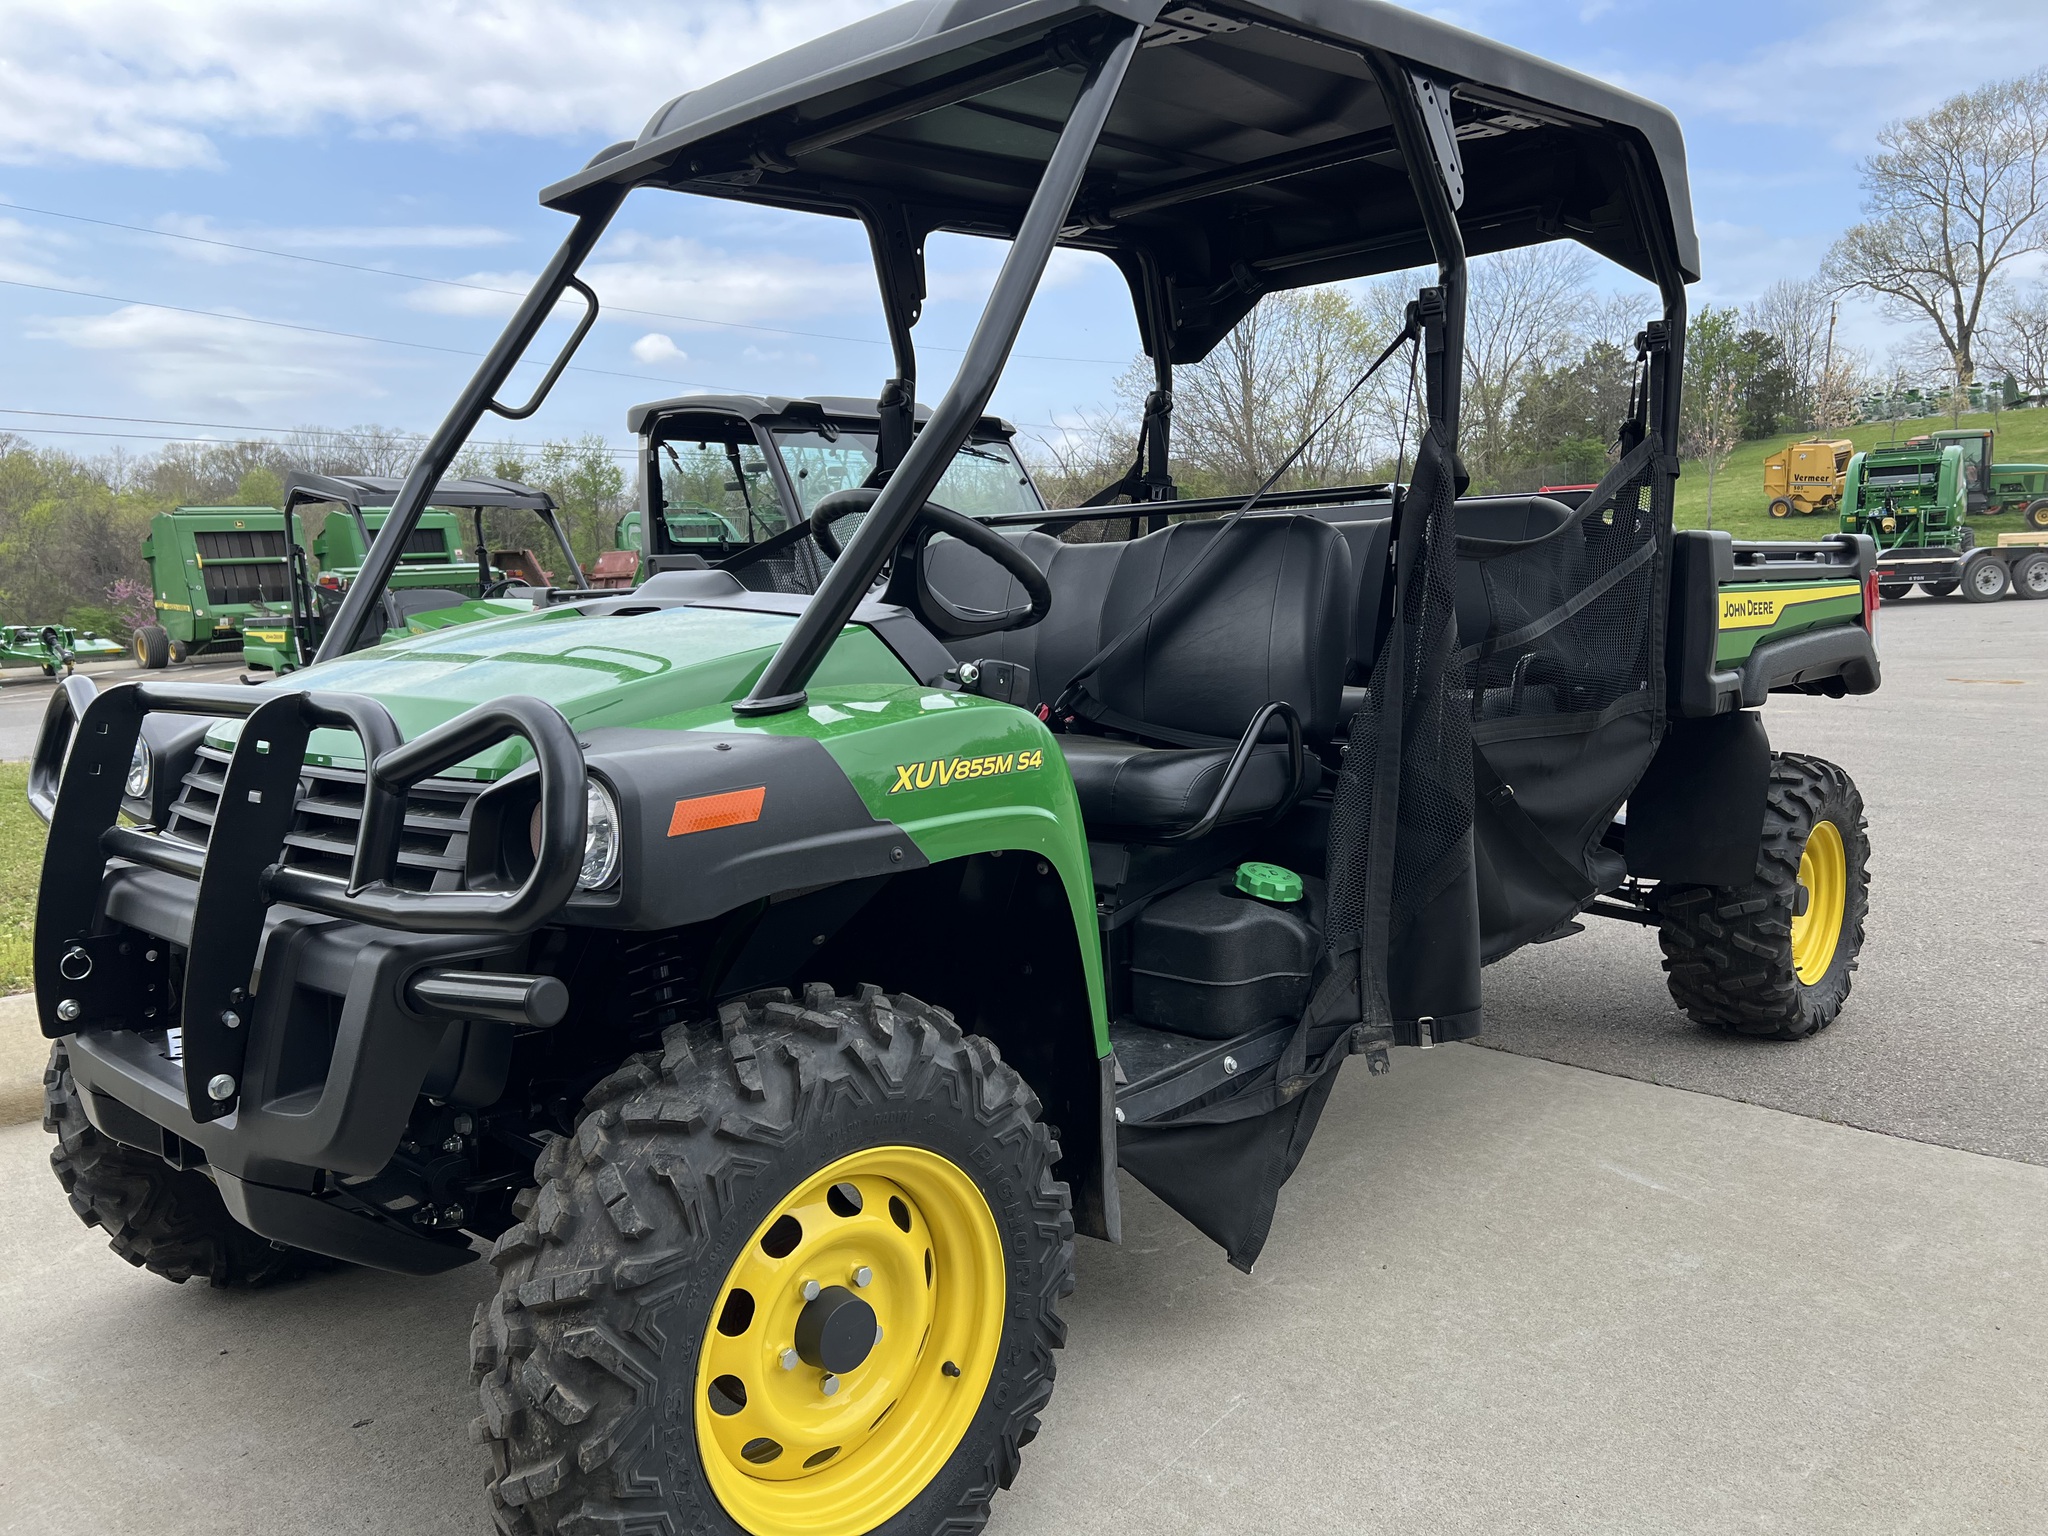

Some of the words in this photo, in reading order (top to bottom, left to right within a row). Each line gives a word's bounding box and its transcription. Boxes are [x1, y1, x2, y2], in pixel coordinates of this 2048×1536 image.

[1794, 473, 1830, 482] Vermeer
[1724, 600, 1746, 618] JOHN
[1748, 599, 1774, 616] DEERE
[888, 754, 1015, 794] XUV855M
[1016, 749, 1043, 771] S4
[872, 1110, 915, 1127] RADIAL
[968, 1143, 1033, 1321] BIGHORN
